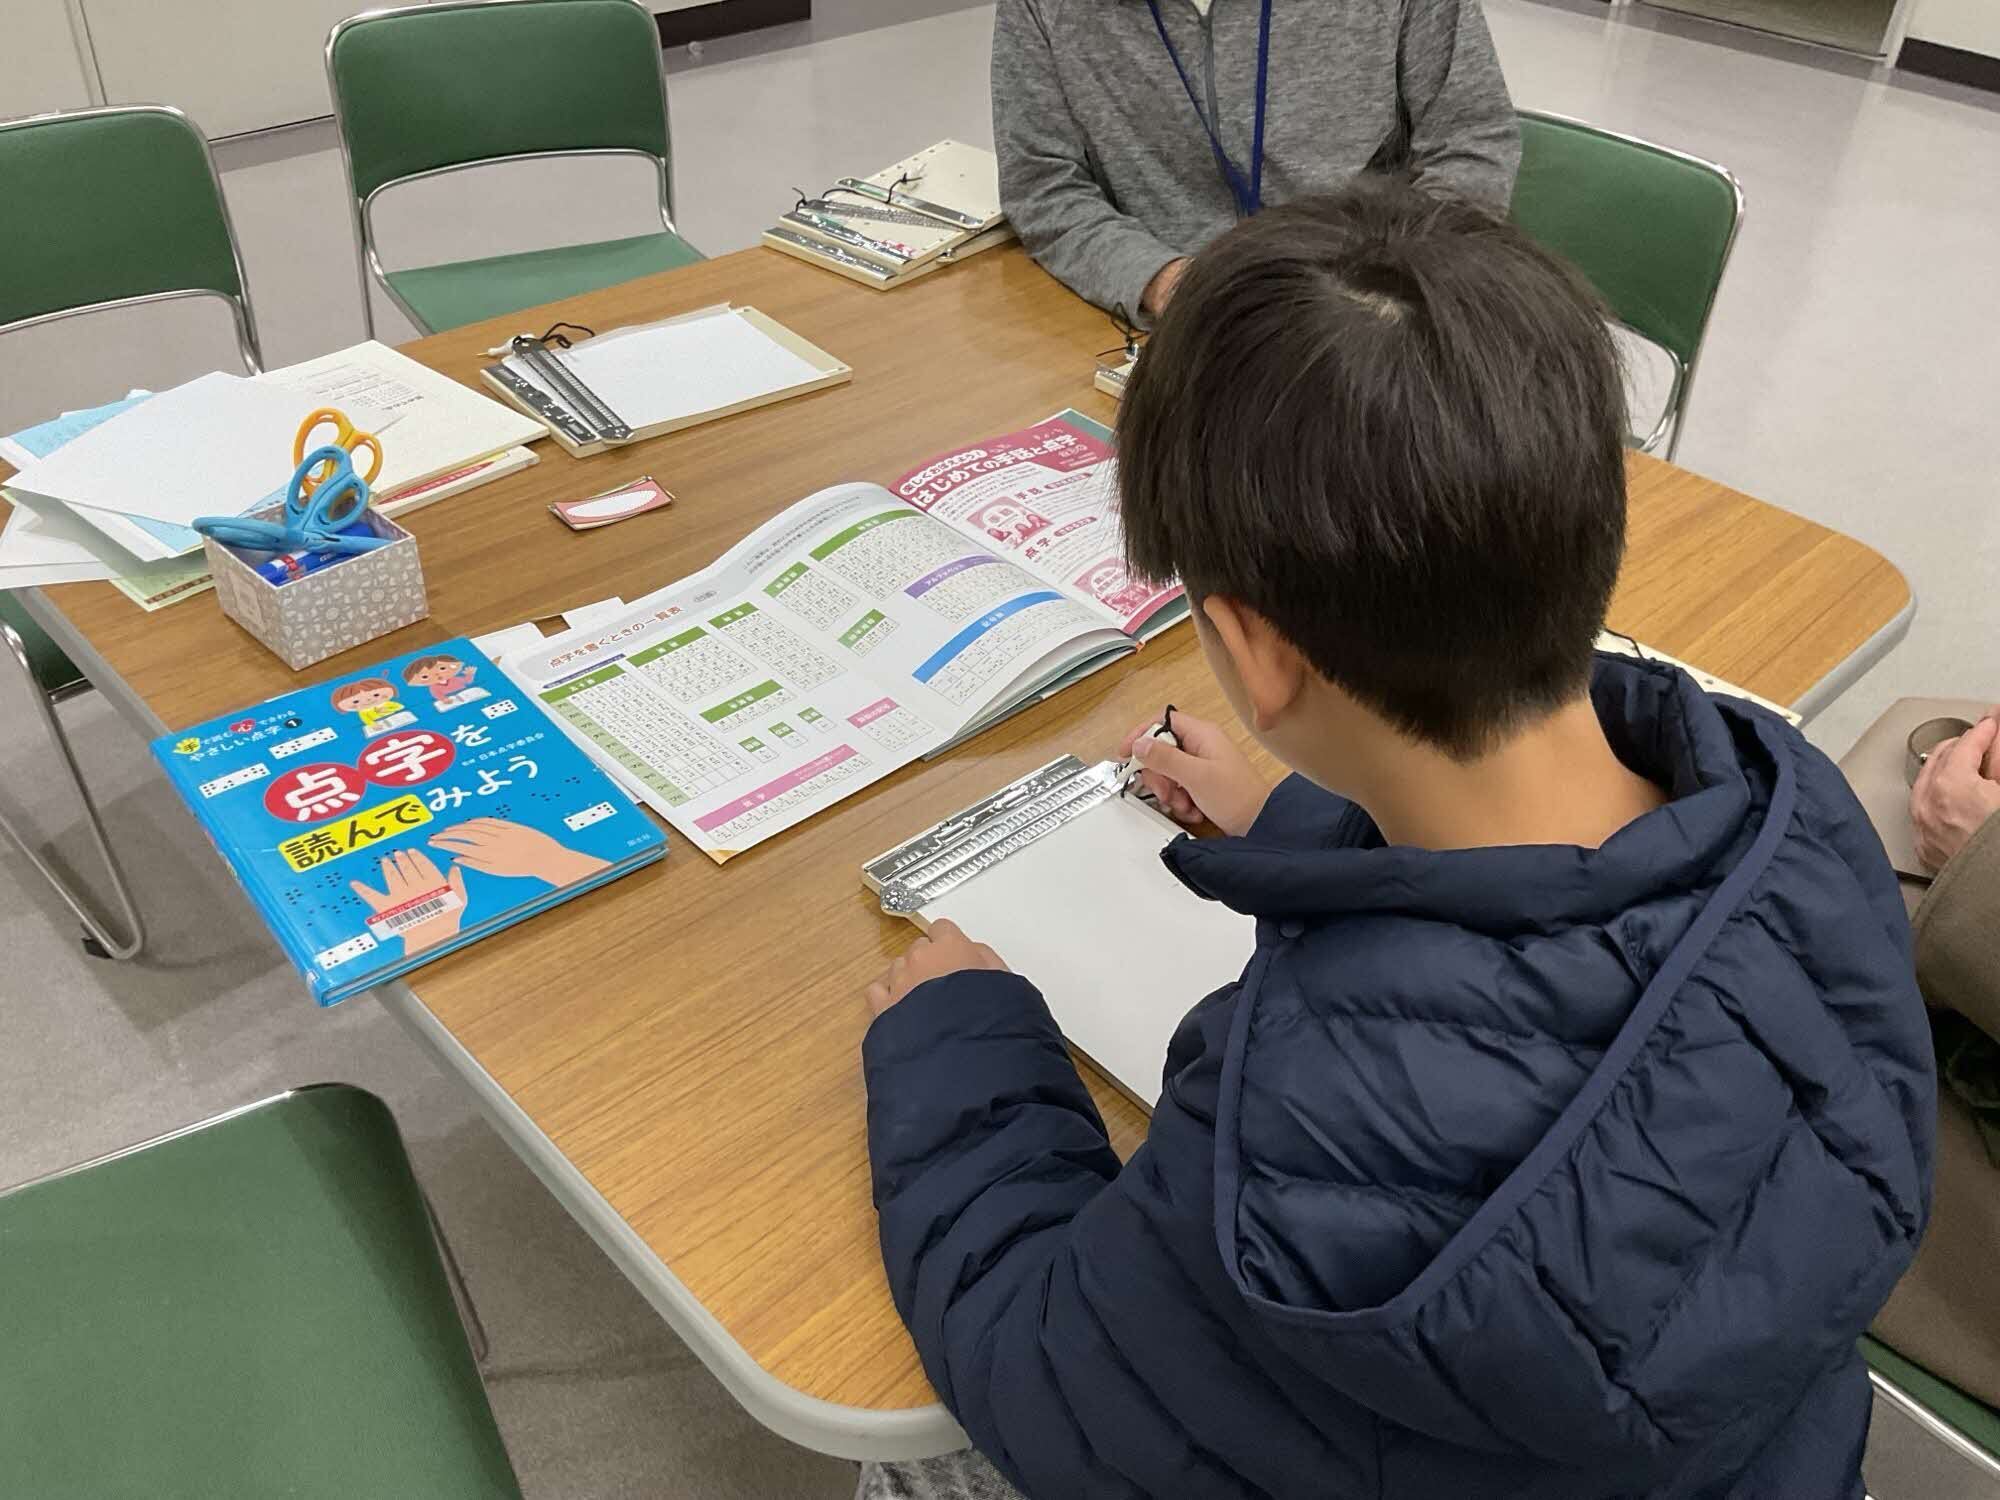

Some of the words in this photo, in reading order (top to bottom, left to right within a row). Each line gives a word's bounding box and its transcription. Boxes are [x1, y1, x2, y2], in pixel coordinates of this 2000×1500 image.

[911, 434, 1079, 507] はじめての手話と点字
[550, 606, 683, 668] 点字を書くときの一覧表
[190, 725, 281, 761] やさしい点字
[283, 724, 492, 822] 点字を
[285, 756, 538, 869] 読んでみよう
